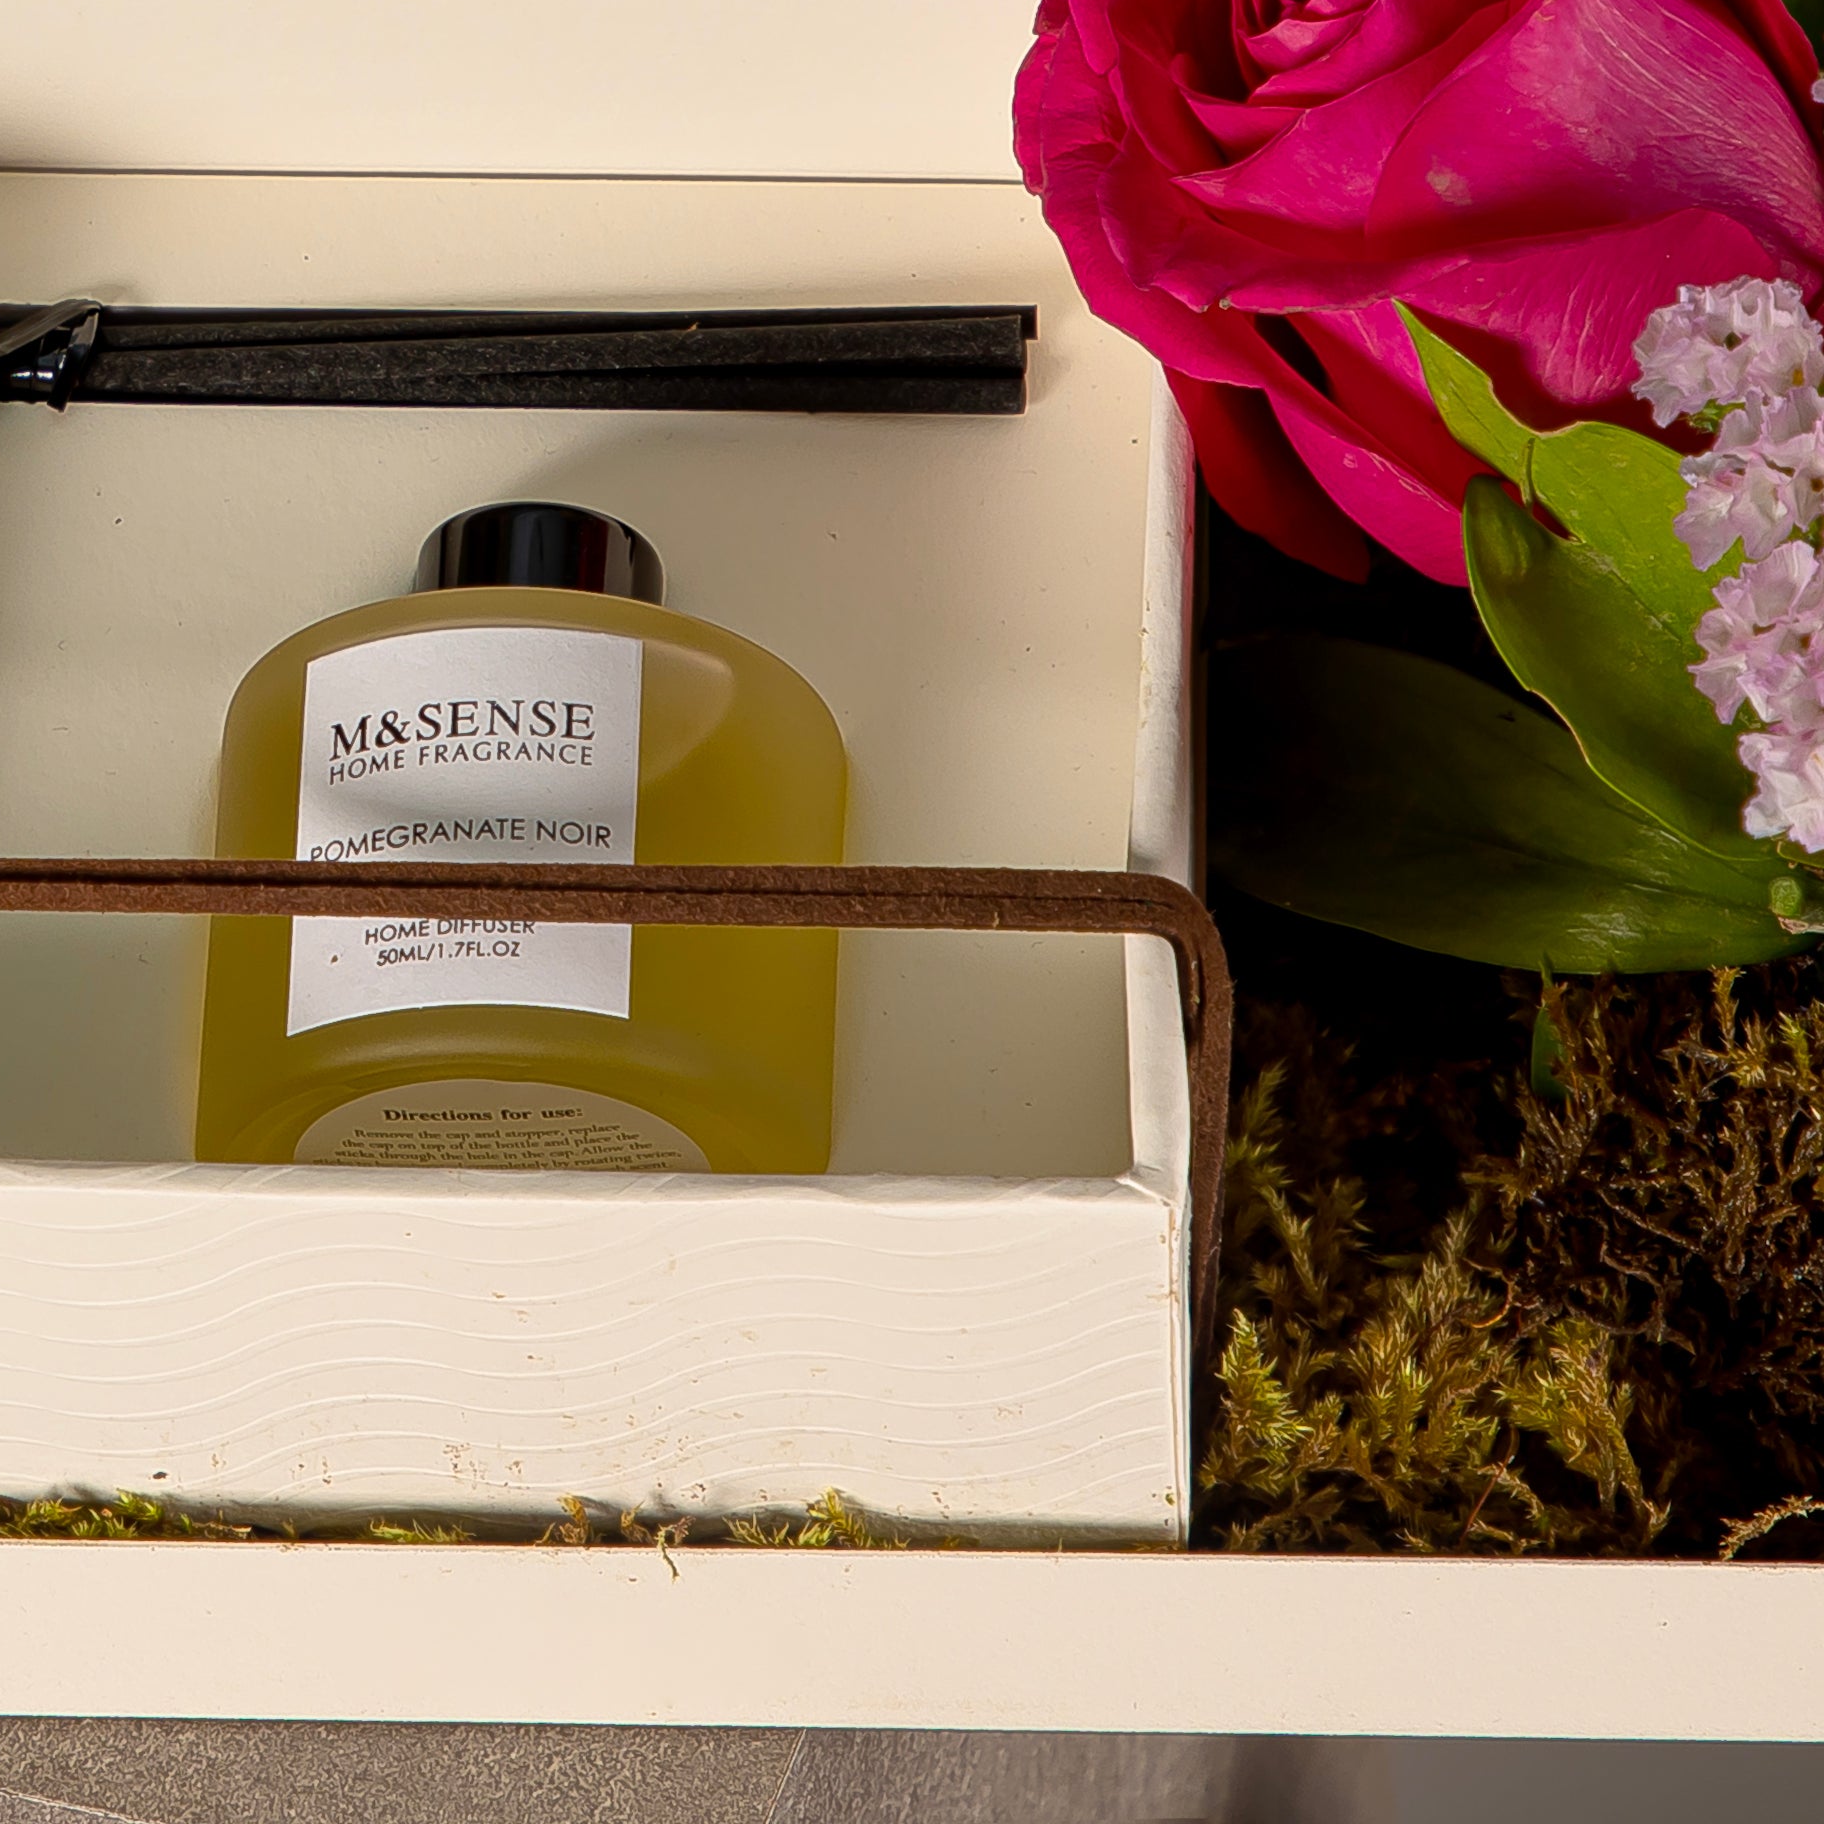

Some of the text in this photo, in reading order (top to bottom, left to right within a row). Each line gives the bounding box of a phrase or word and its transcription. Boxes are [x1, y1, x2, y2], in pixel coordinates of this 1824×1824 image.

[327, 700, 596, 763] M&SENSE
[328, 742, 594, 786] HOME FRAGRANCE
[309, 817, 613, 861] POMEGRANATE NOIR
[364, 919, 536, 946] HOME DIFFUSER
[376, 940, 521, 967] 50ML/1.7FL.OZ
[383, 1107, 584, 1122] Directions for use:
[342, 1132, 640, 1153] the cap on top of the bottle and place the
[354, 1129, 414, 1139] Remove
[418, 1129, 443, 1139] the
[445, 1132, 471, 1143] cap
[475, 1129, 501, 1139] and
[568, 1124, 621, 1137] replace
[379, 1150, 437, 1163] through
[440, 1152, 464, 1161] the
[502, 1151, 518, 1160] in
[521, 1150, 545, 1159] the
[581, 1145, 624, 1156] Allow
[629, 1142, 653, 1151] the
